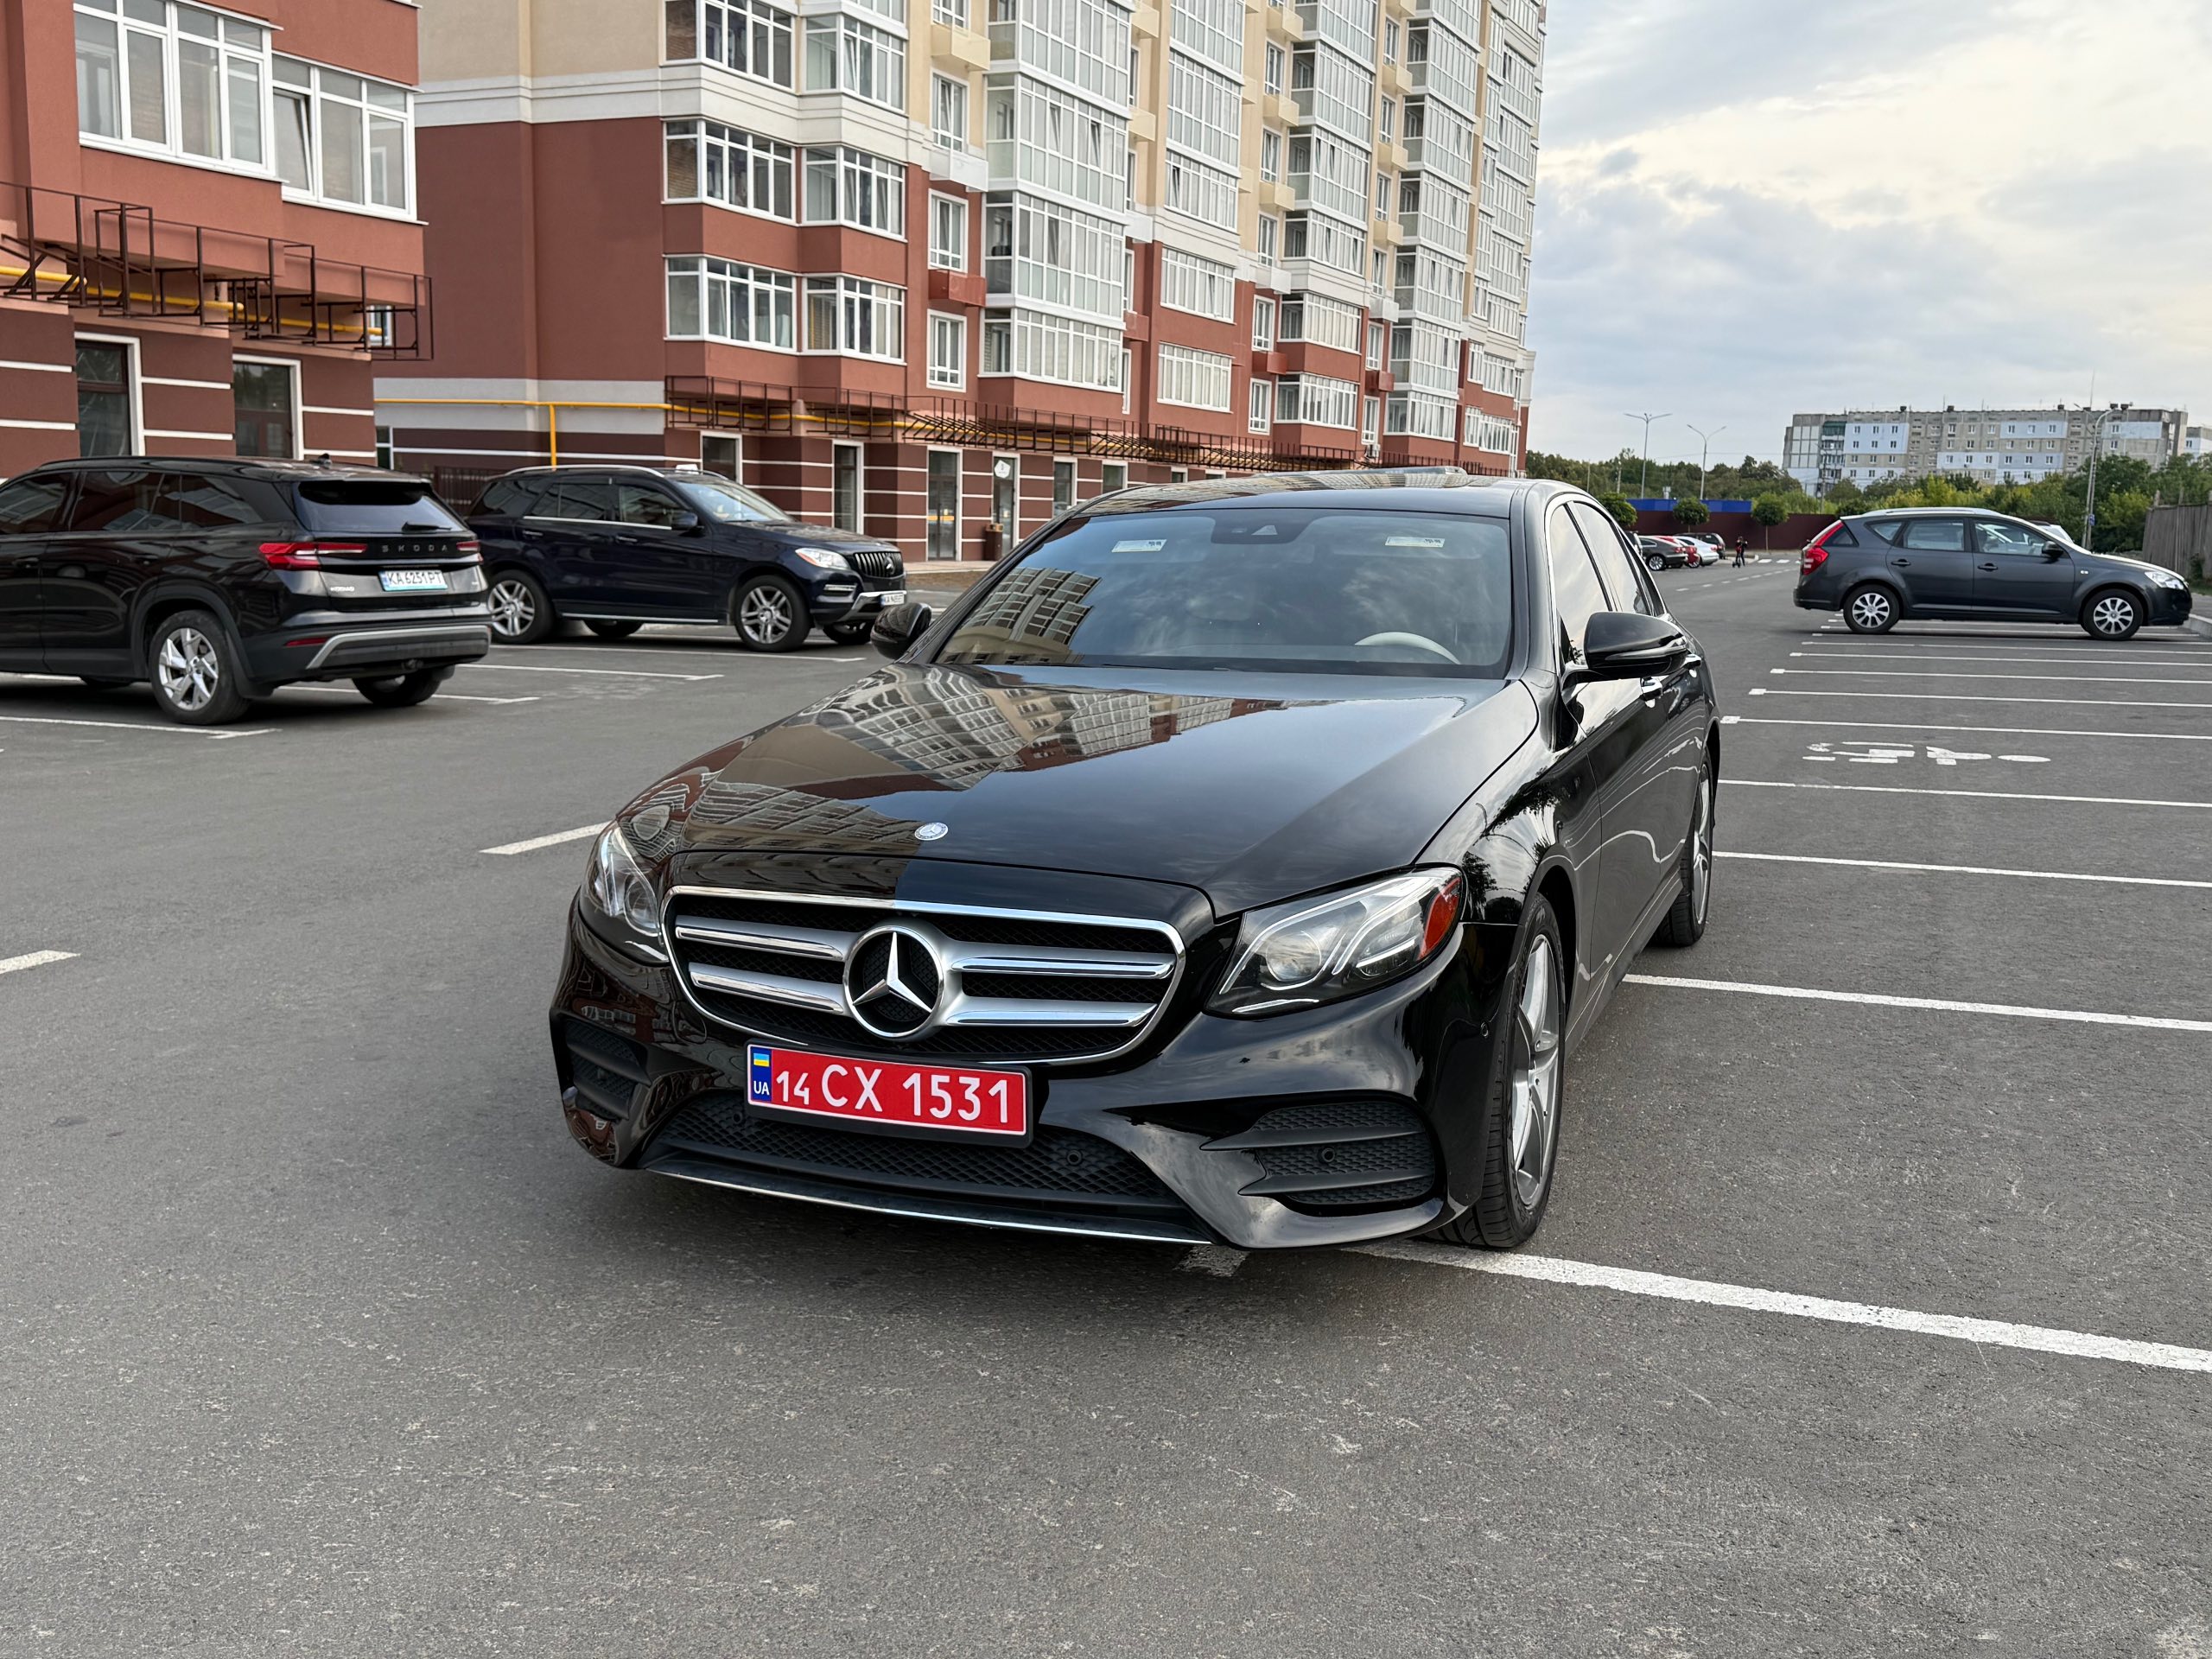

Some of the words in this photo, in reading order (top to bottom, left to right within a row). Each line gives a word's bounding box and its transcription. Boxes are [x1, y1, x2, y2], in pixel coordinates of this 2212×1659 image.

[753, 1080, 770, 1096] UA
[776, 1071, 810, 1106] 14
[822, 1064, 883, 1112] CX
[902, 1072, 1008, 1124] 1531
